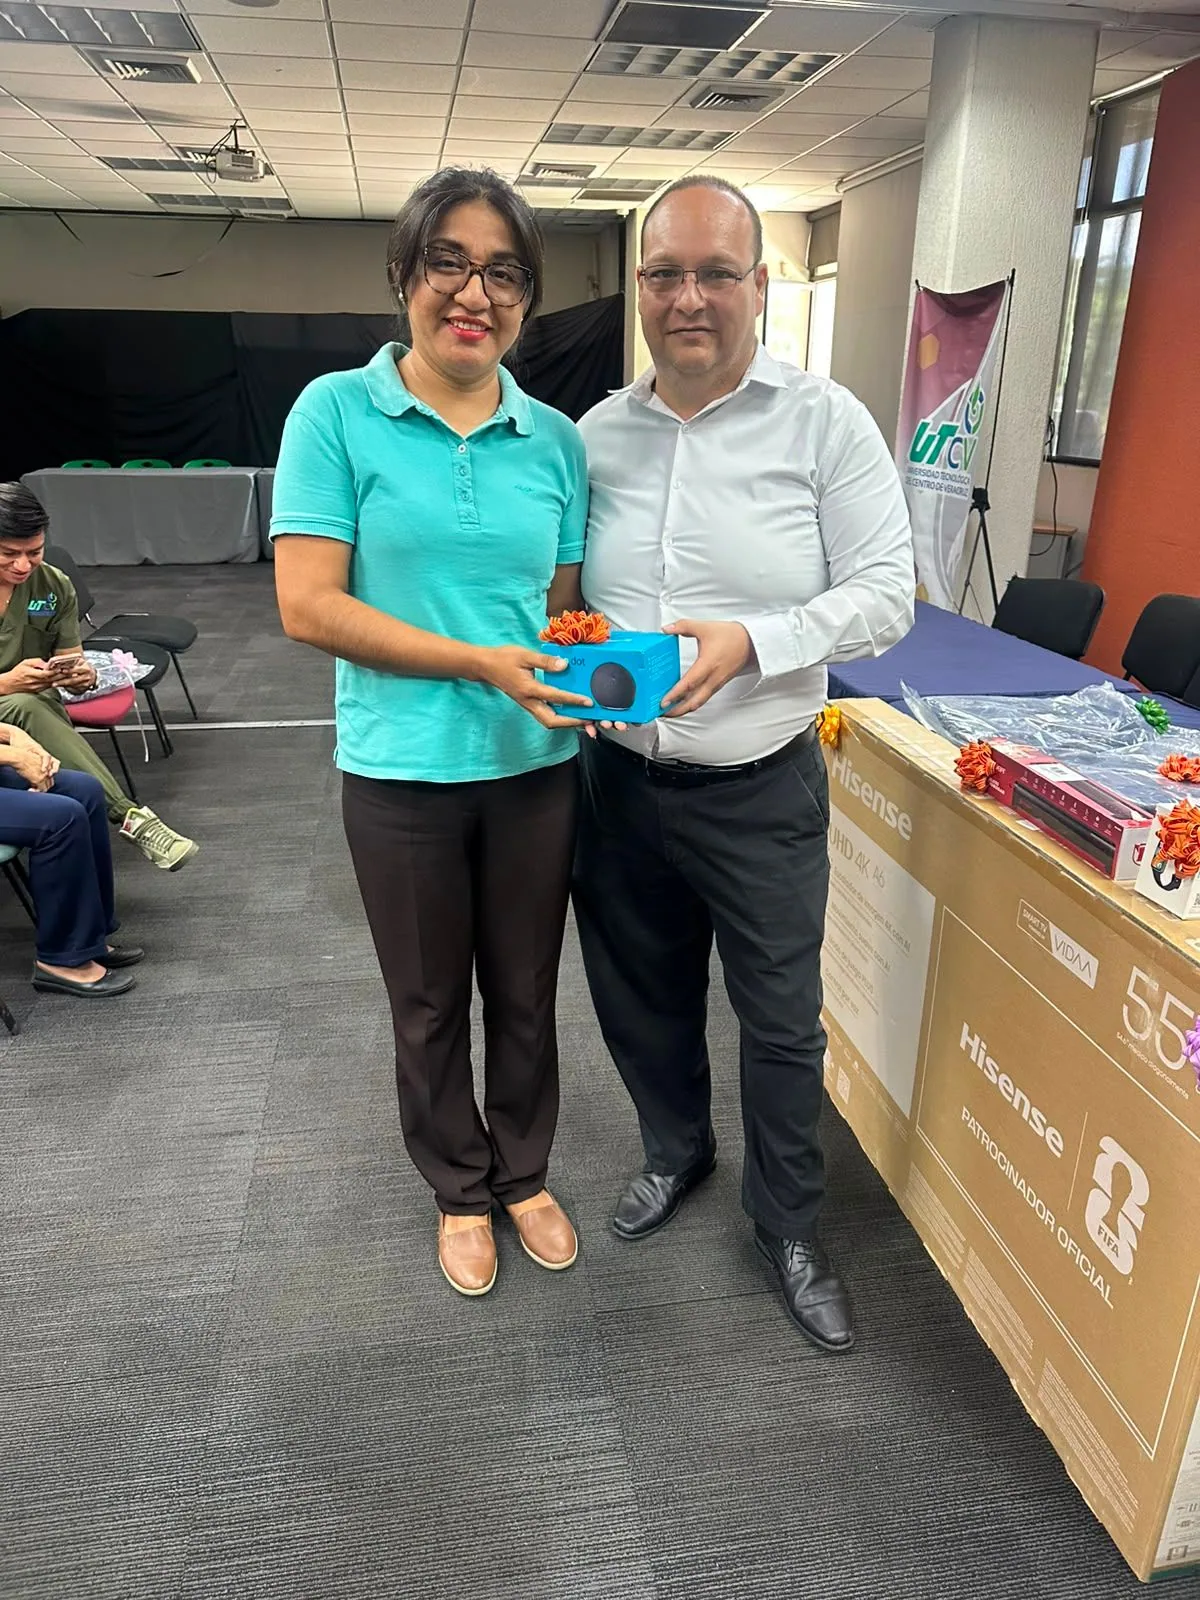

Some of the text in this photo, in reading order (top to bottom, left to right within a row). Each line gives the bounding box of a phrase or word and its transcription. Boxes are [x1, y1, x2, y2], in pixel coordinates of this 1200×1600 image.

[912, 478, 935, 490] CENTRO
[935, 482, 944, 491] DE
[570, 656, 586, 666] dot
[831, 753, 913, 841] Hisense
[829, 823, 854, 861] UHD
[855, 850, 871, 880] 4K
[1055, 934, 1092, 979] VIDAA
[1122, 965, 1195, 1071] 55
[959, 1021, 1064, 1159] Hisense
[960, 1105, 1056, 1233] PATROCINADOR
[1056, 1224, 1114, 1310] OFICIAL
[1097, 1224, 1119, 1258] FIFA
